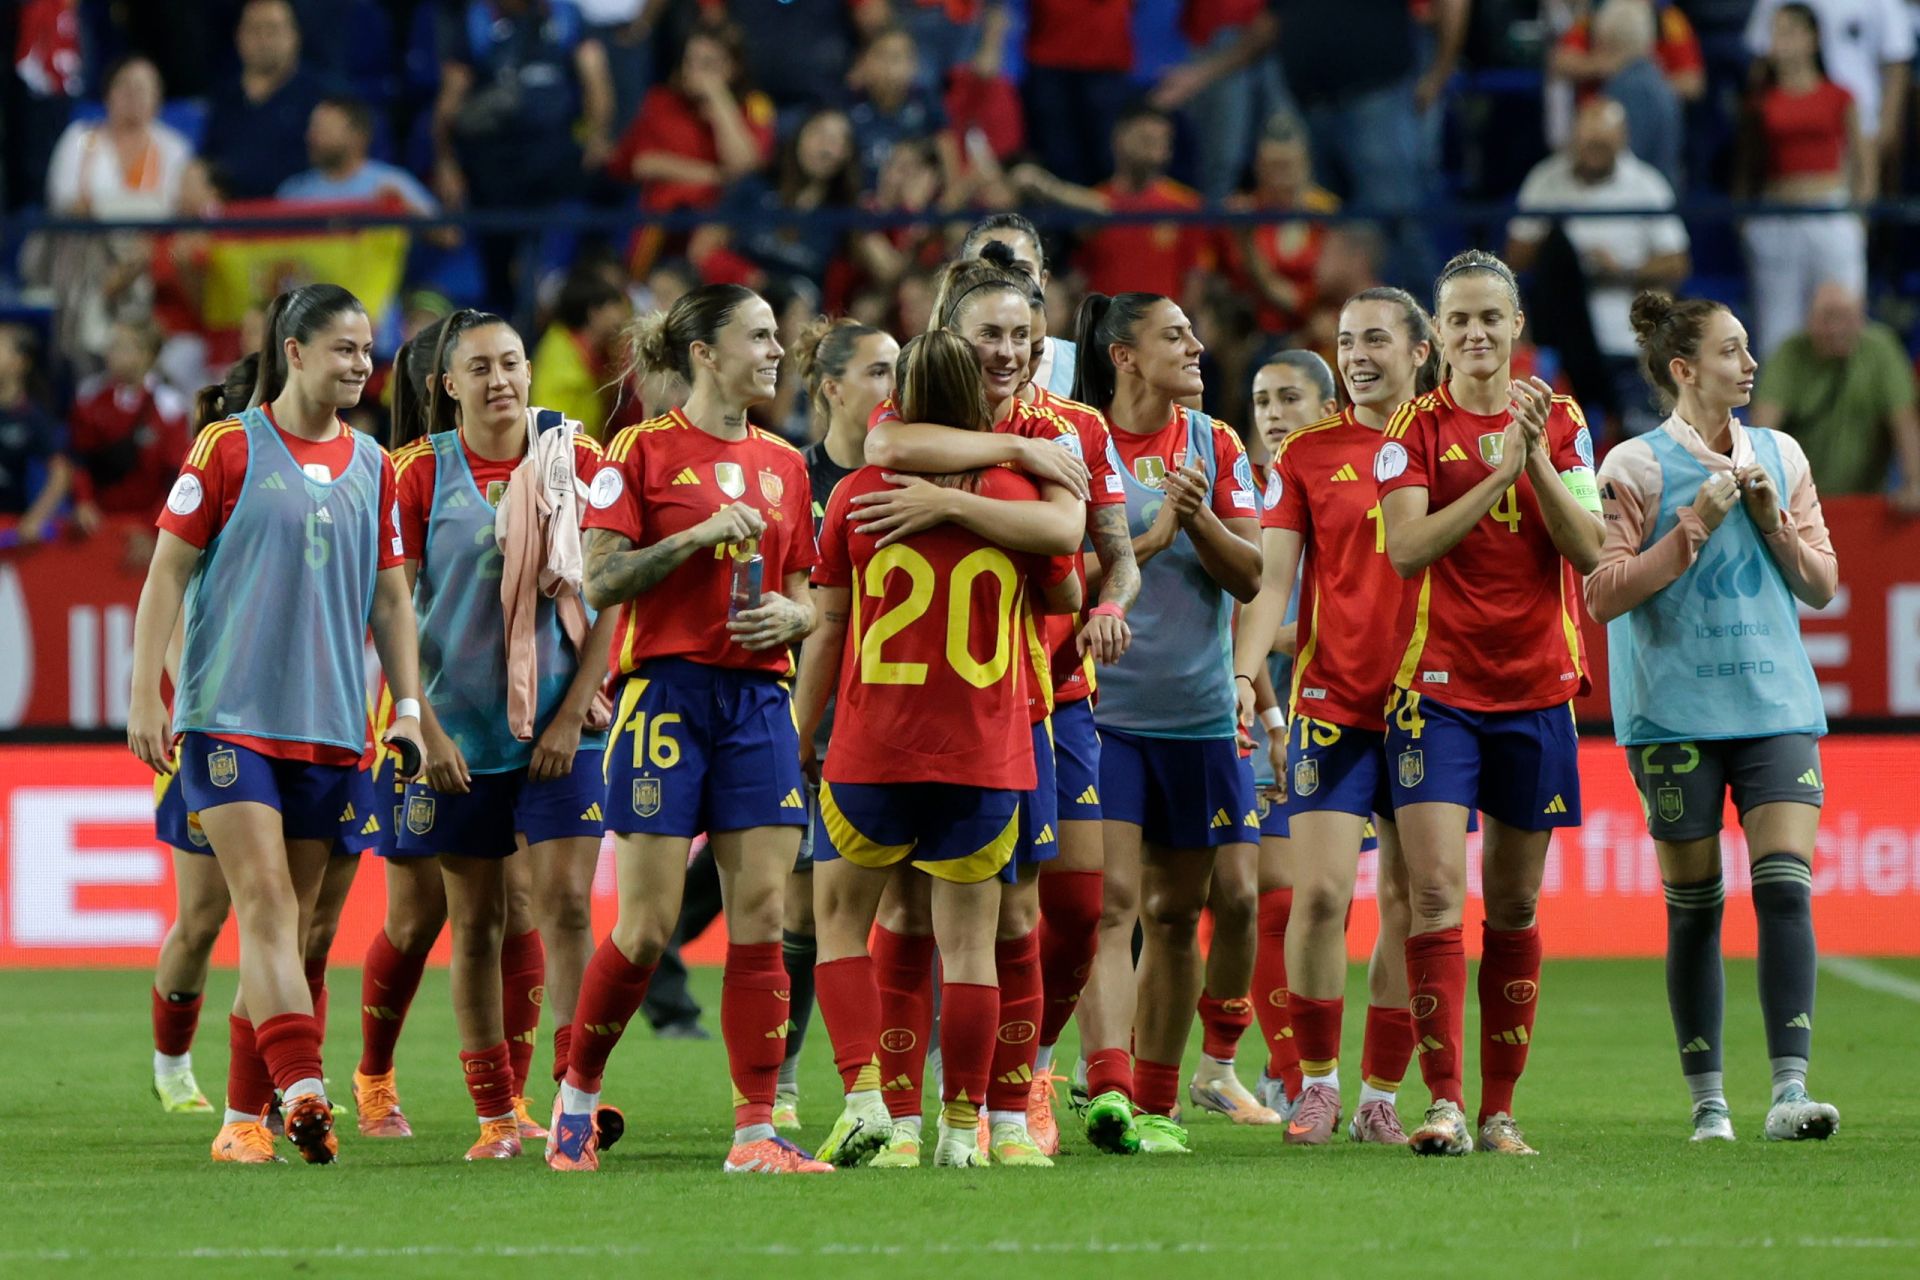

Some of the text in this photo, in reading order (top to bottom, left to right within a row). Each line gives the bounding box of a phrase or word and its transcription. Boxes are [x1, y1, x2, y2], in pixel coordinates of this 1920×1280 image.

[1490, 484, 1522, 532] 4
[861, 543, 1017, 689] 20
[1695, 620, 1770, 639] Iberdrola
[1396, 689, 1425, 739] 4
[625, 712, 682, 770] 16
